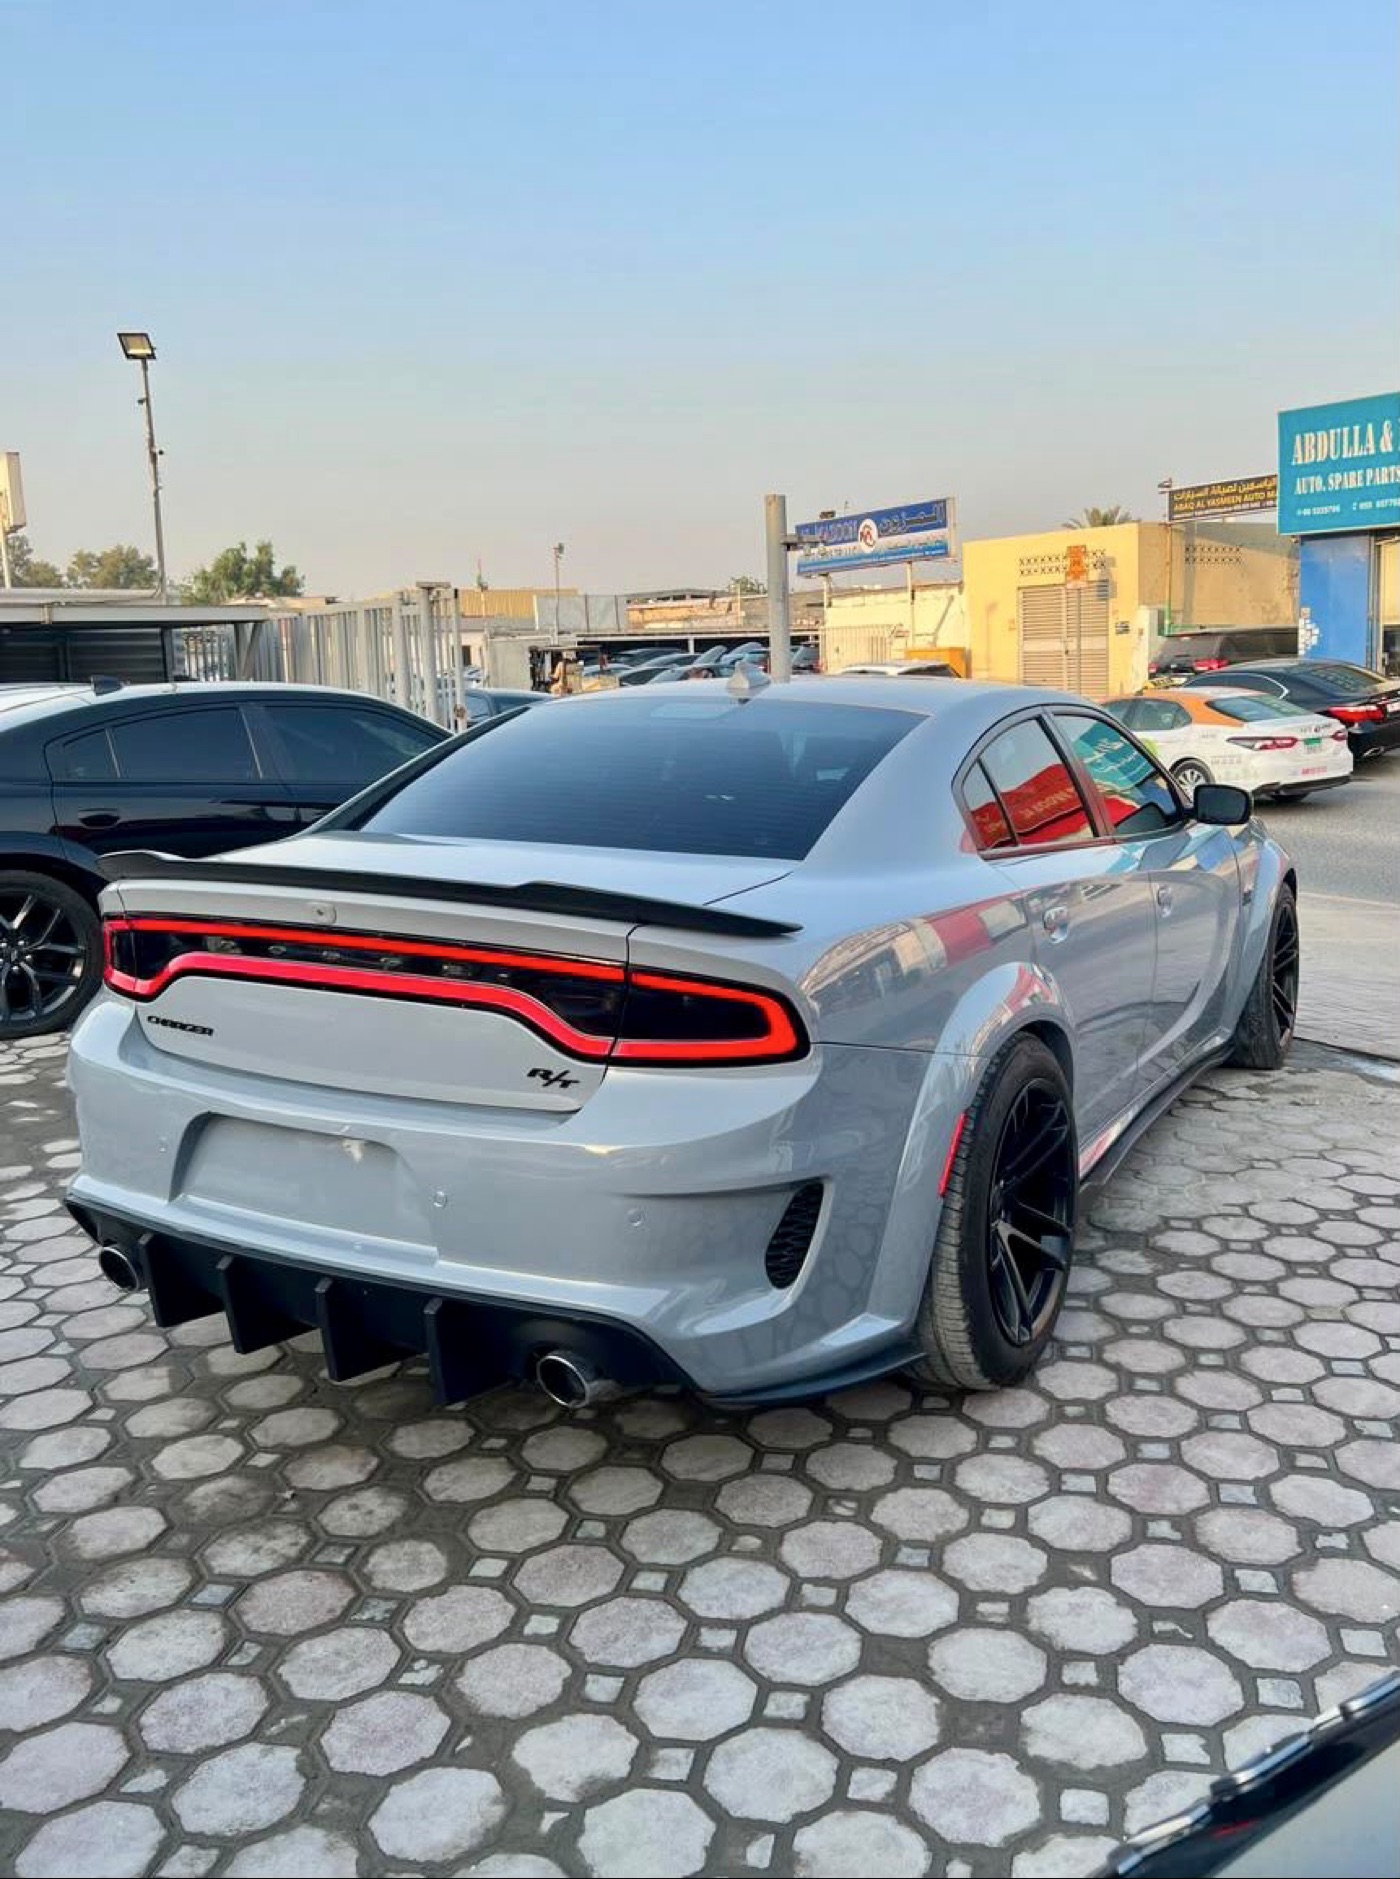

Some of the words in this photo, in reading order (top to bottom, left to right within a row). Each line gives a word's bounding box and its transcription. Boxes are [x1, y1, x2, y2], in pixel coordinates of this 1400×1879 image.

[1292, 422, 1375, 466] ABDULLA
[1380, 420, 1393, 453] &
[1328, 469, 1364, 491] SPARE
[1243, 491, 1266, 502] AUTO
[147, 1015, 213, 1036] CHARGER
[527, 1067, 580, 1088] R/T
